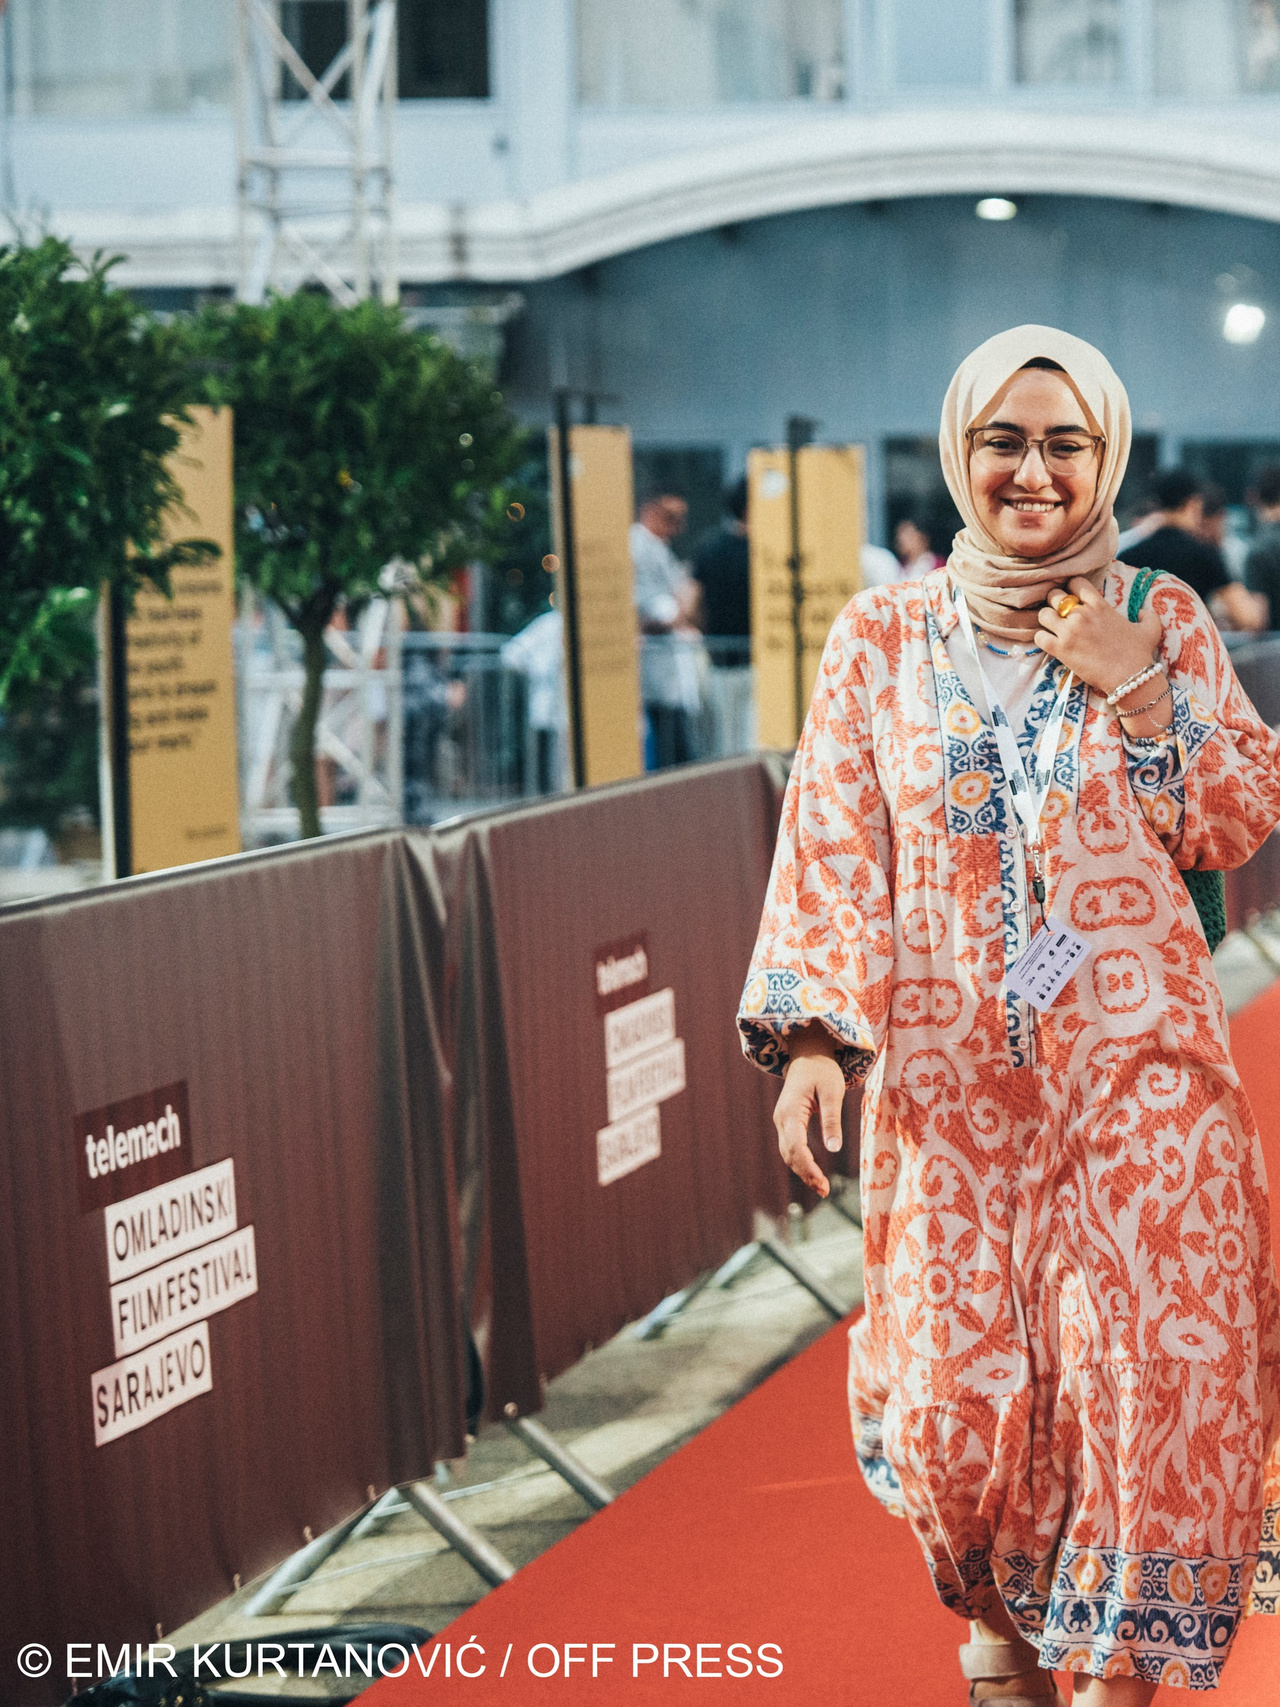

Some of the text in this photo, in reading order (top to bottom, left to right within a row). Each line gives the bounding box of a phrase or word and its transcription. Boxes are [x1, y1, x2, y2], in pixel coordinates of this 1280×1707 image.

[86, 1104, 181, 1179] telemach
[113, 1177, 233, 1261] OMLADINSKI
[97, 1339, 206, 1428] SARAJEVO
